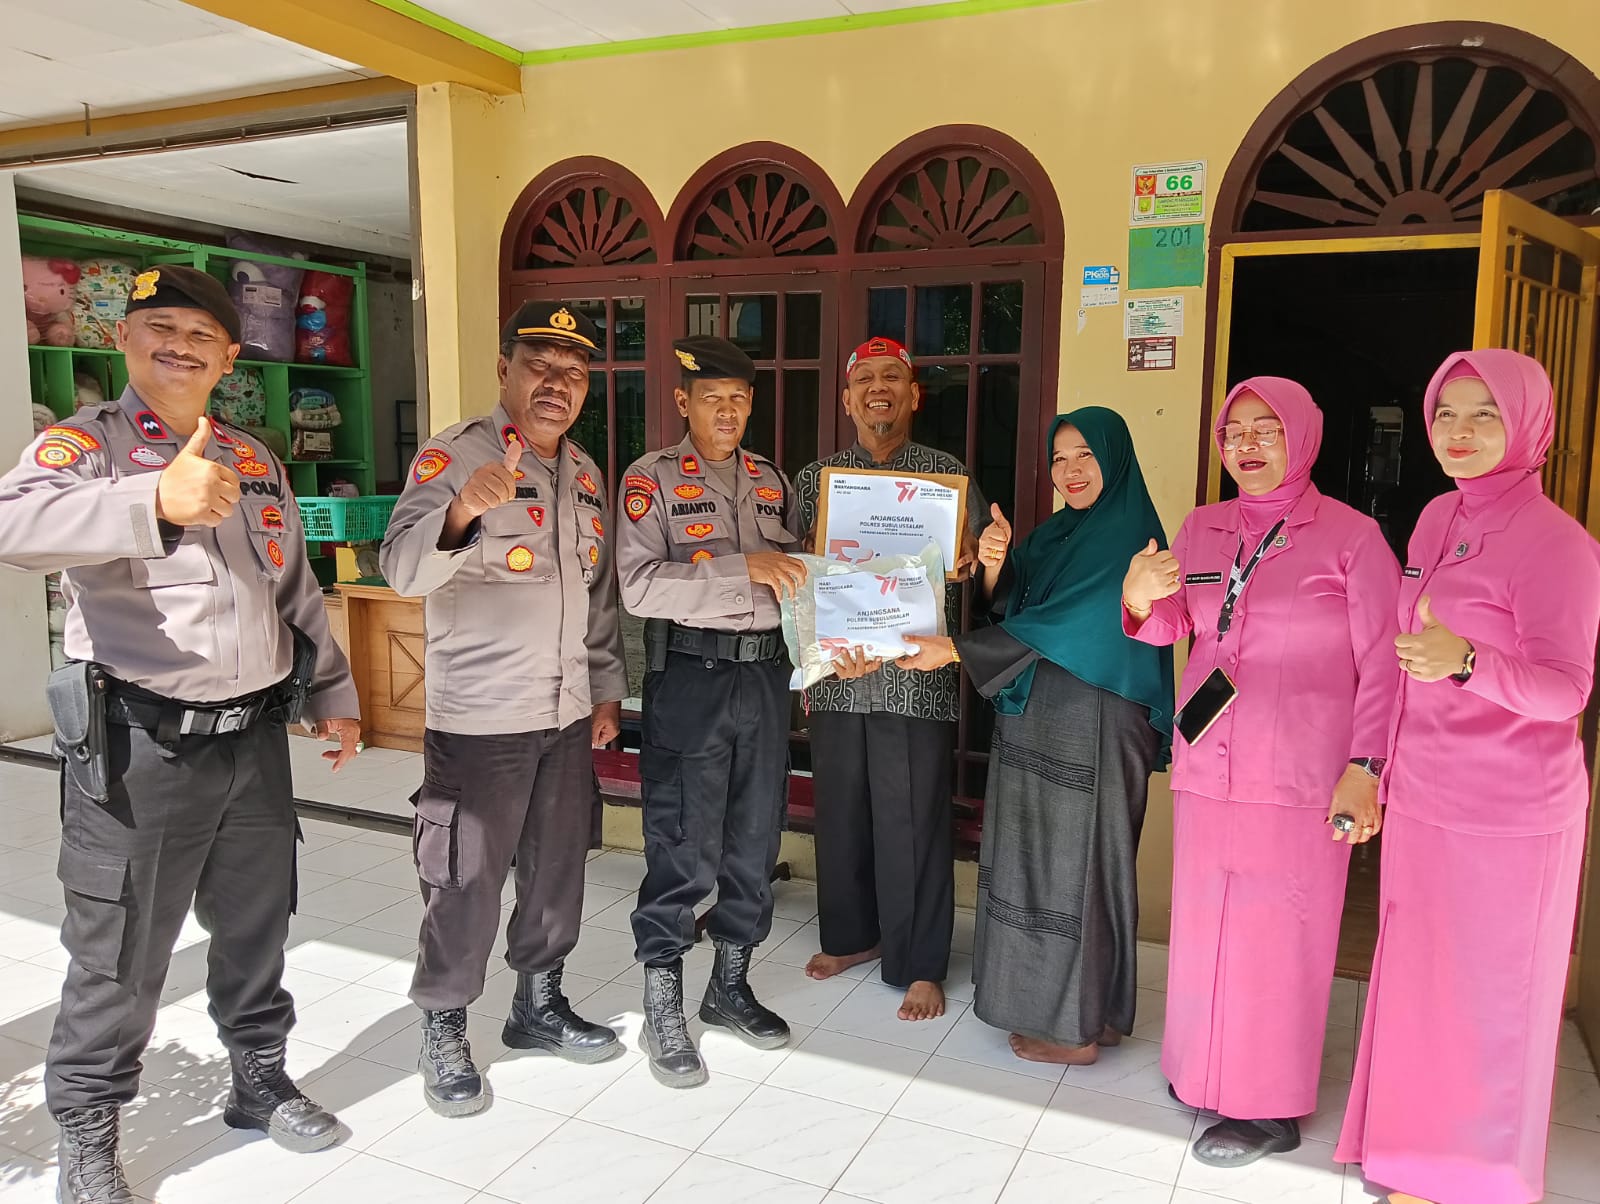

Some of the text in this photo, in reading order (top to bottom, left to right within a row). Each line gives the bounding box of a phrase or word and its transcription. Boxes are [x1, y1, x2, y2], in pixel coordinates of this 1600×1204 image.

[1166, 175, 1193, 191] 66
[1156, 227, 1191, 247] 201
[240, 480, 281, 498] POLR
[671, 501, 716, 516] ARIANTO
[756, 503, 784, 516] POLR
[857, 607, 901, 616] ANJANGSANA
